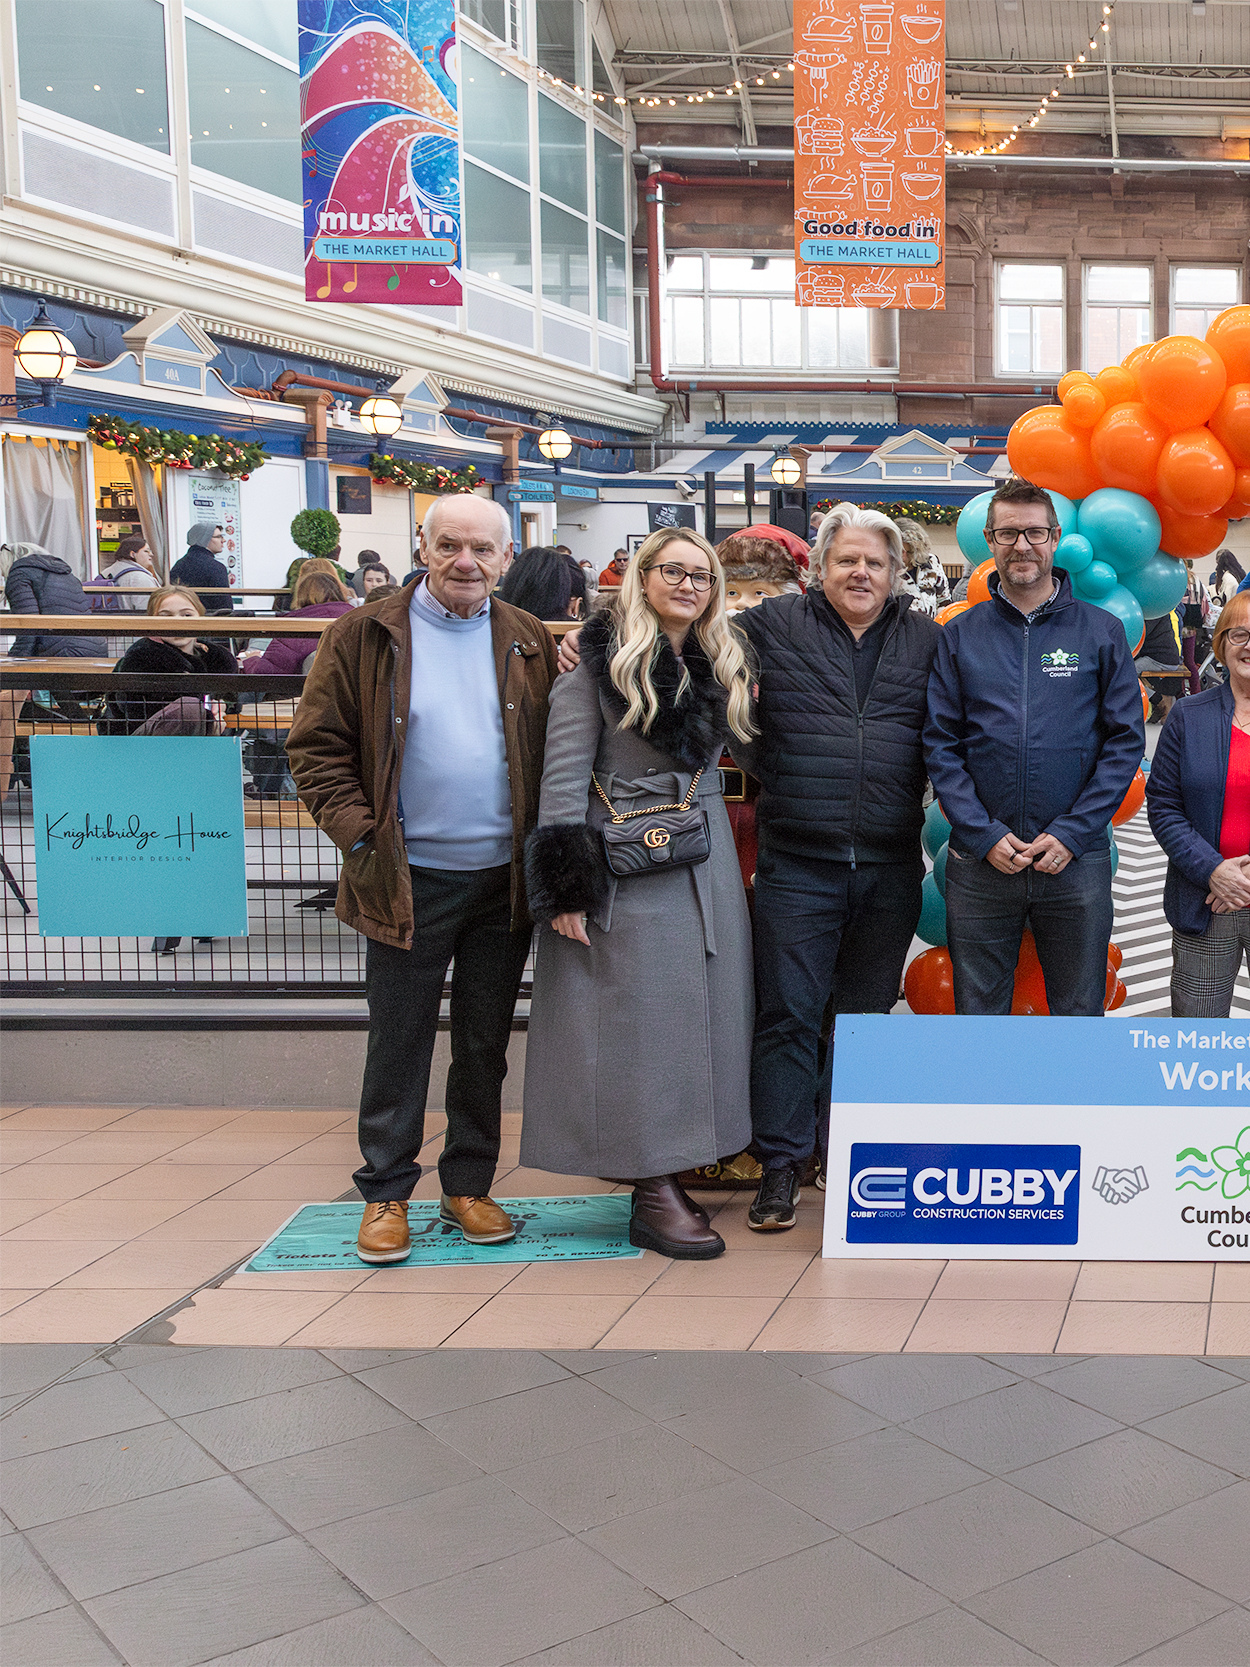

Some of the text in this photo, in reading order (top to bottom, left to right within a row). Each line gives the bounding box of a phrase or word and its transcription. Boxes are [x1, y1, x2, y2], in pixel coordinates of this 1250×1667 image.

[319, 208, 454, 233] music in
[804, 219, 935, 238] Good food in
[323, 244, 447, 257] THE MARKET HALL
[808, 245, 931, 259] THE MARKET HALL
[165, 367, 180, 381] 40A
[523, 493, 554, 501] TOILETS
[46, 812, 231, 852] Knightsbridge House
[1129, 1030, 1171, 1049] The
[912, 1167, 1078, 1206] CUBBY
[850, 1210, 877, 1218] CUBBY
[912, 1208, 1065, 1220] CONSTRUCTION SERVICES
